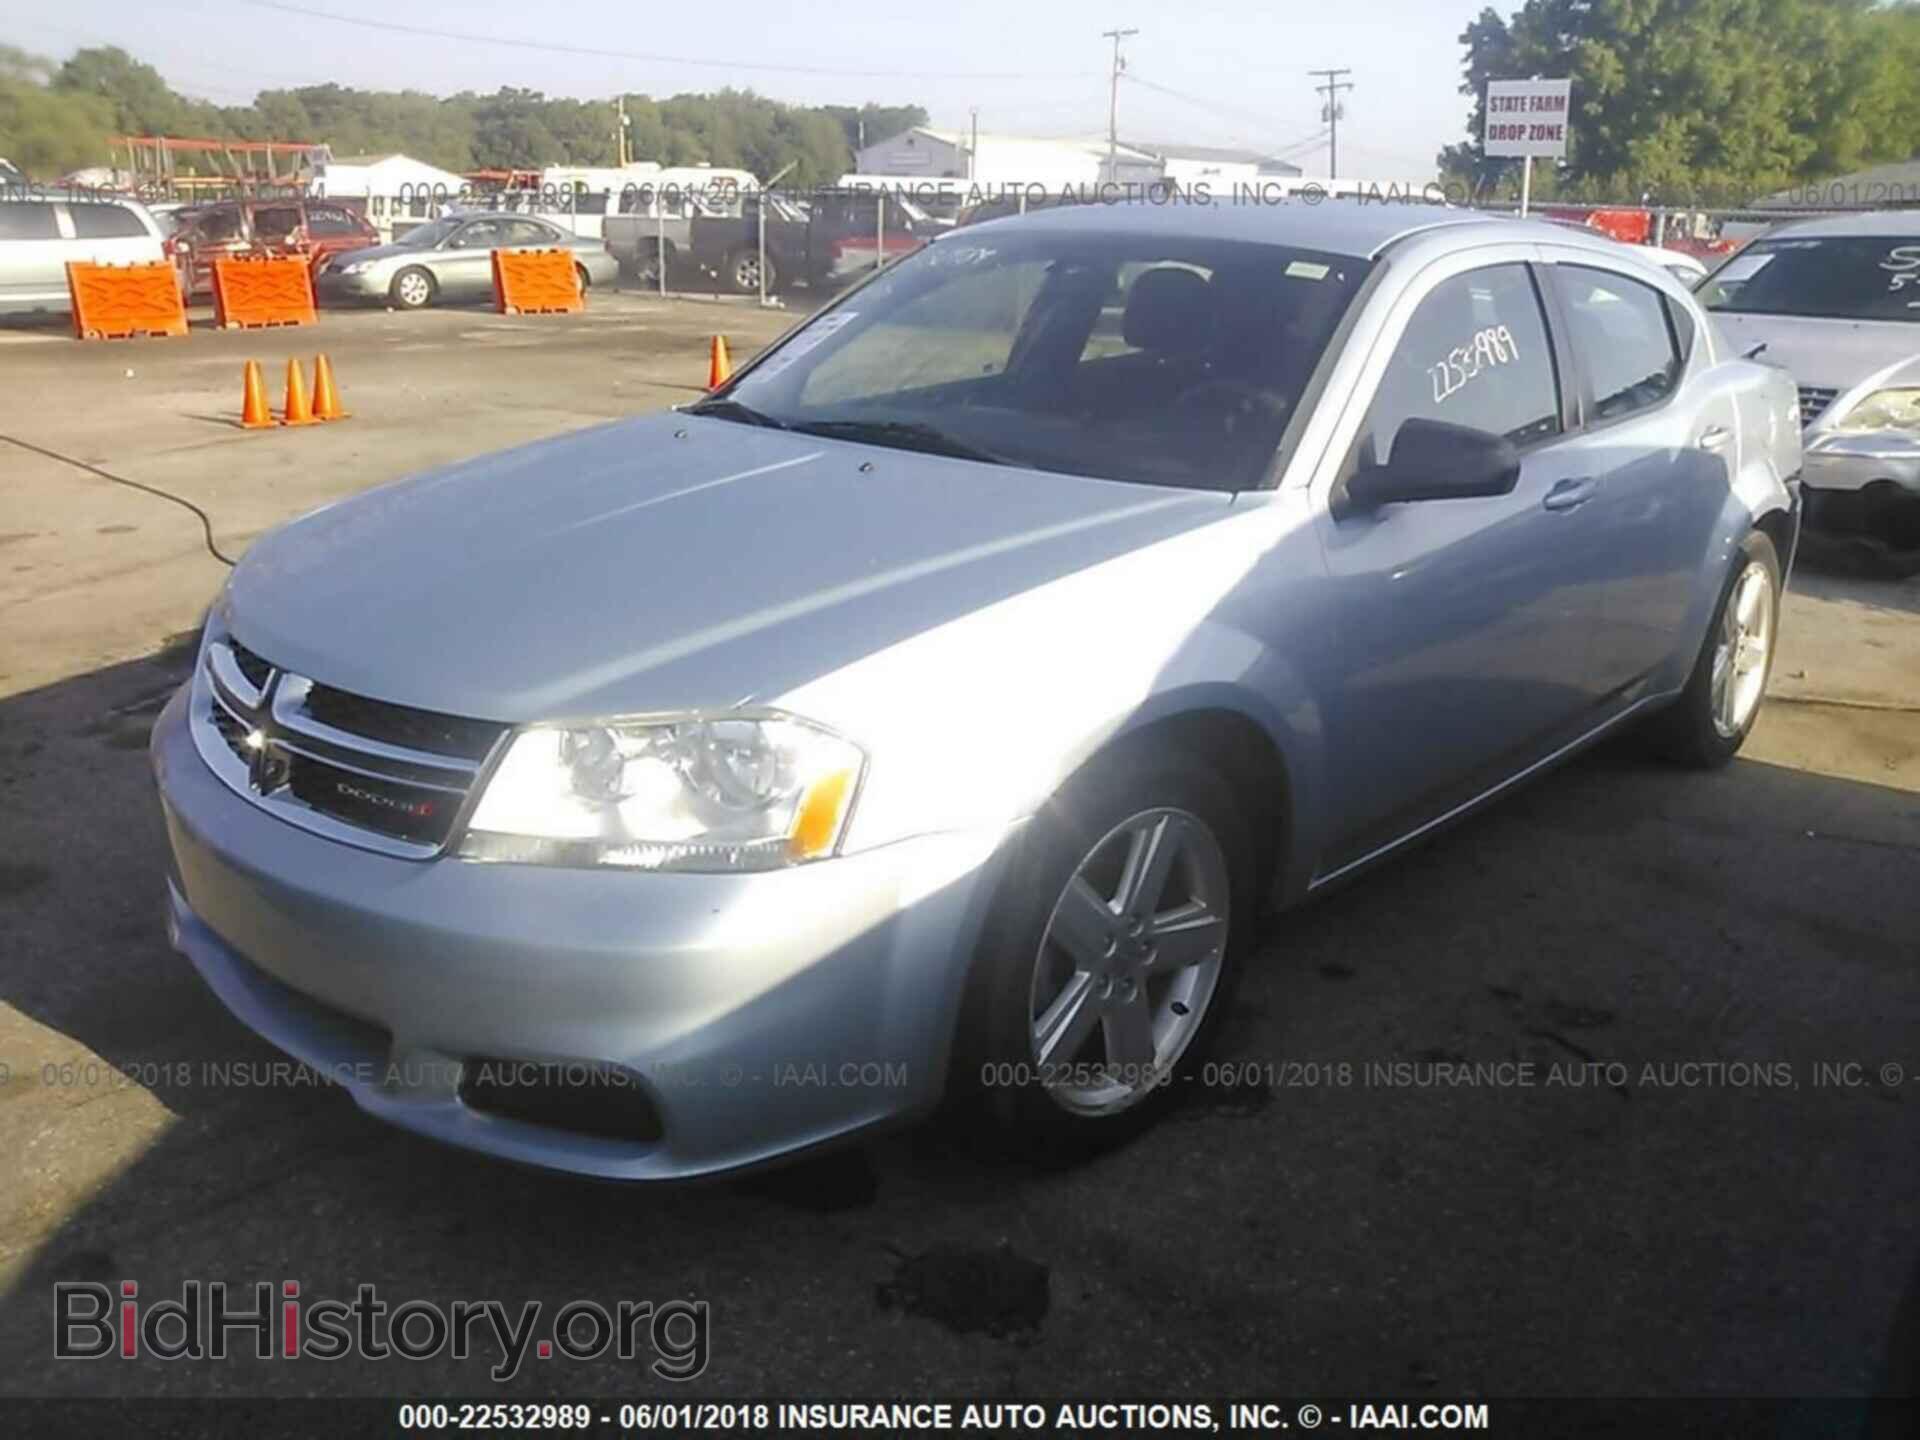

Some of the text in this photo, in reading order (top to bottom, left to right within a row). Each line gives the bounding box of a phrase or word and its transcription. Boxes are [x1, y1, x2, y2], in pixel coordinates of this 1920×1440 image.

[1490, 95, 1566, 113] STATE FARM
[1489, 124, 1563, 141] DROP ZONE
